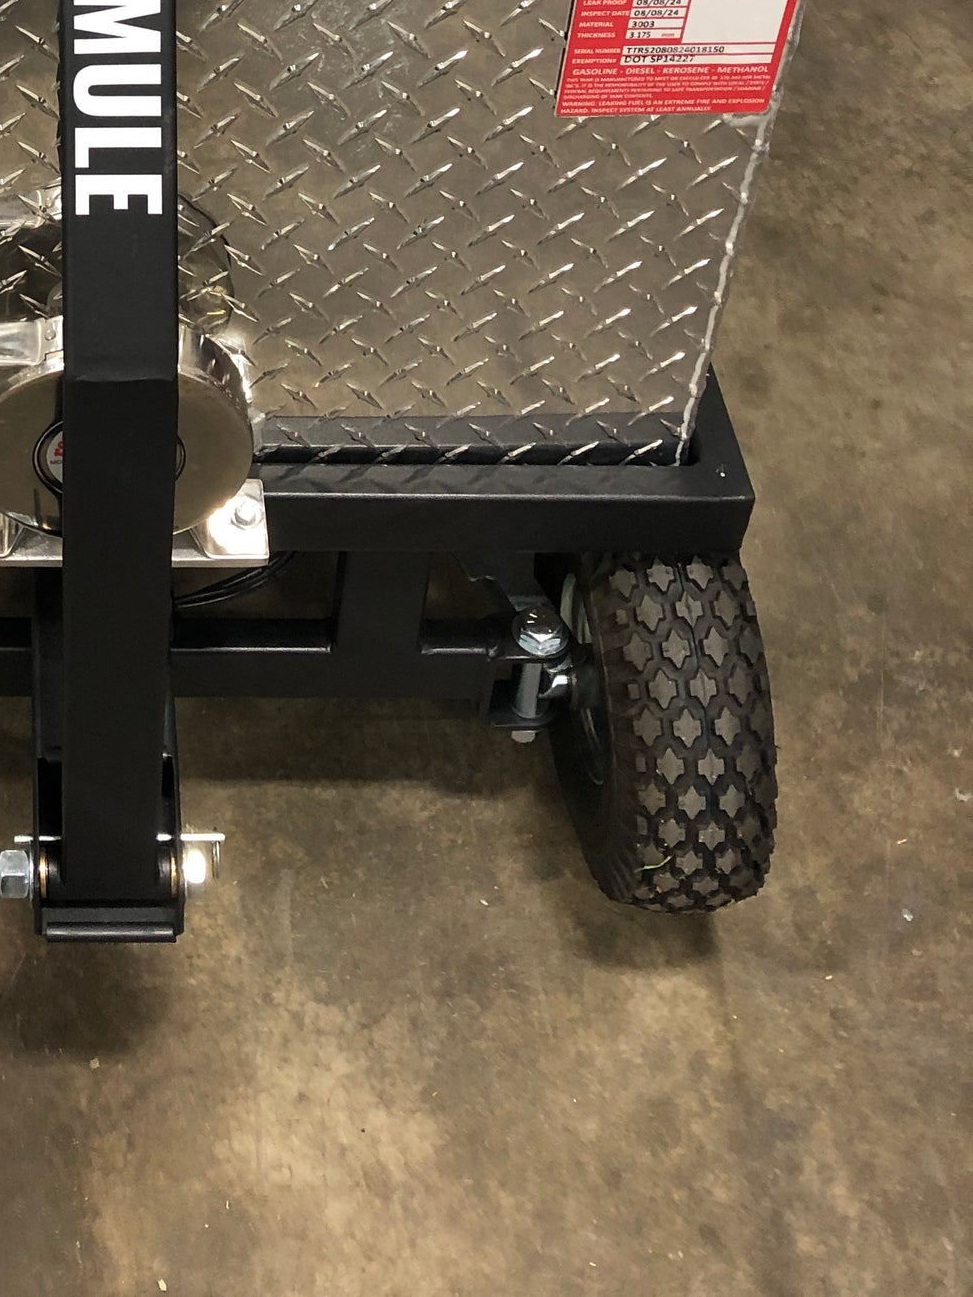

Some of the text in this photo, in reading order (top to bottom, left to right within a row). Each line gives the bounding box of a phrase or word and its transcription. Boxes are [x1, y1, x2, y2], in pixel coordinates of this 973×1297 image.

[633, 9, 680, 17] 08/08/24
[624, 55, 648, 64] DOT
[650, 55, 696, 63] SP14227
[626, 67, 655, 75] DIESEL
[717, 65, 769, 73] METHANOL
